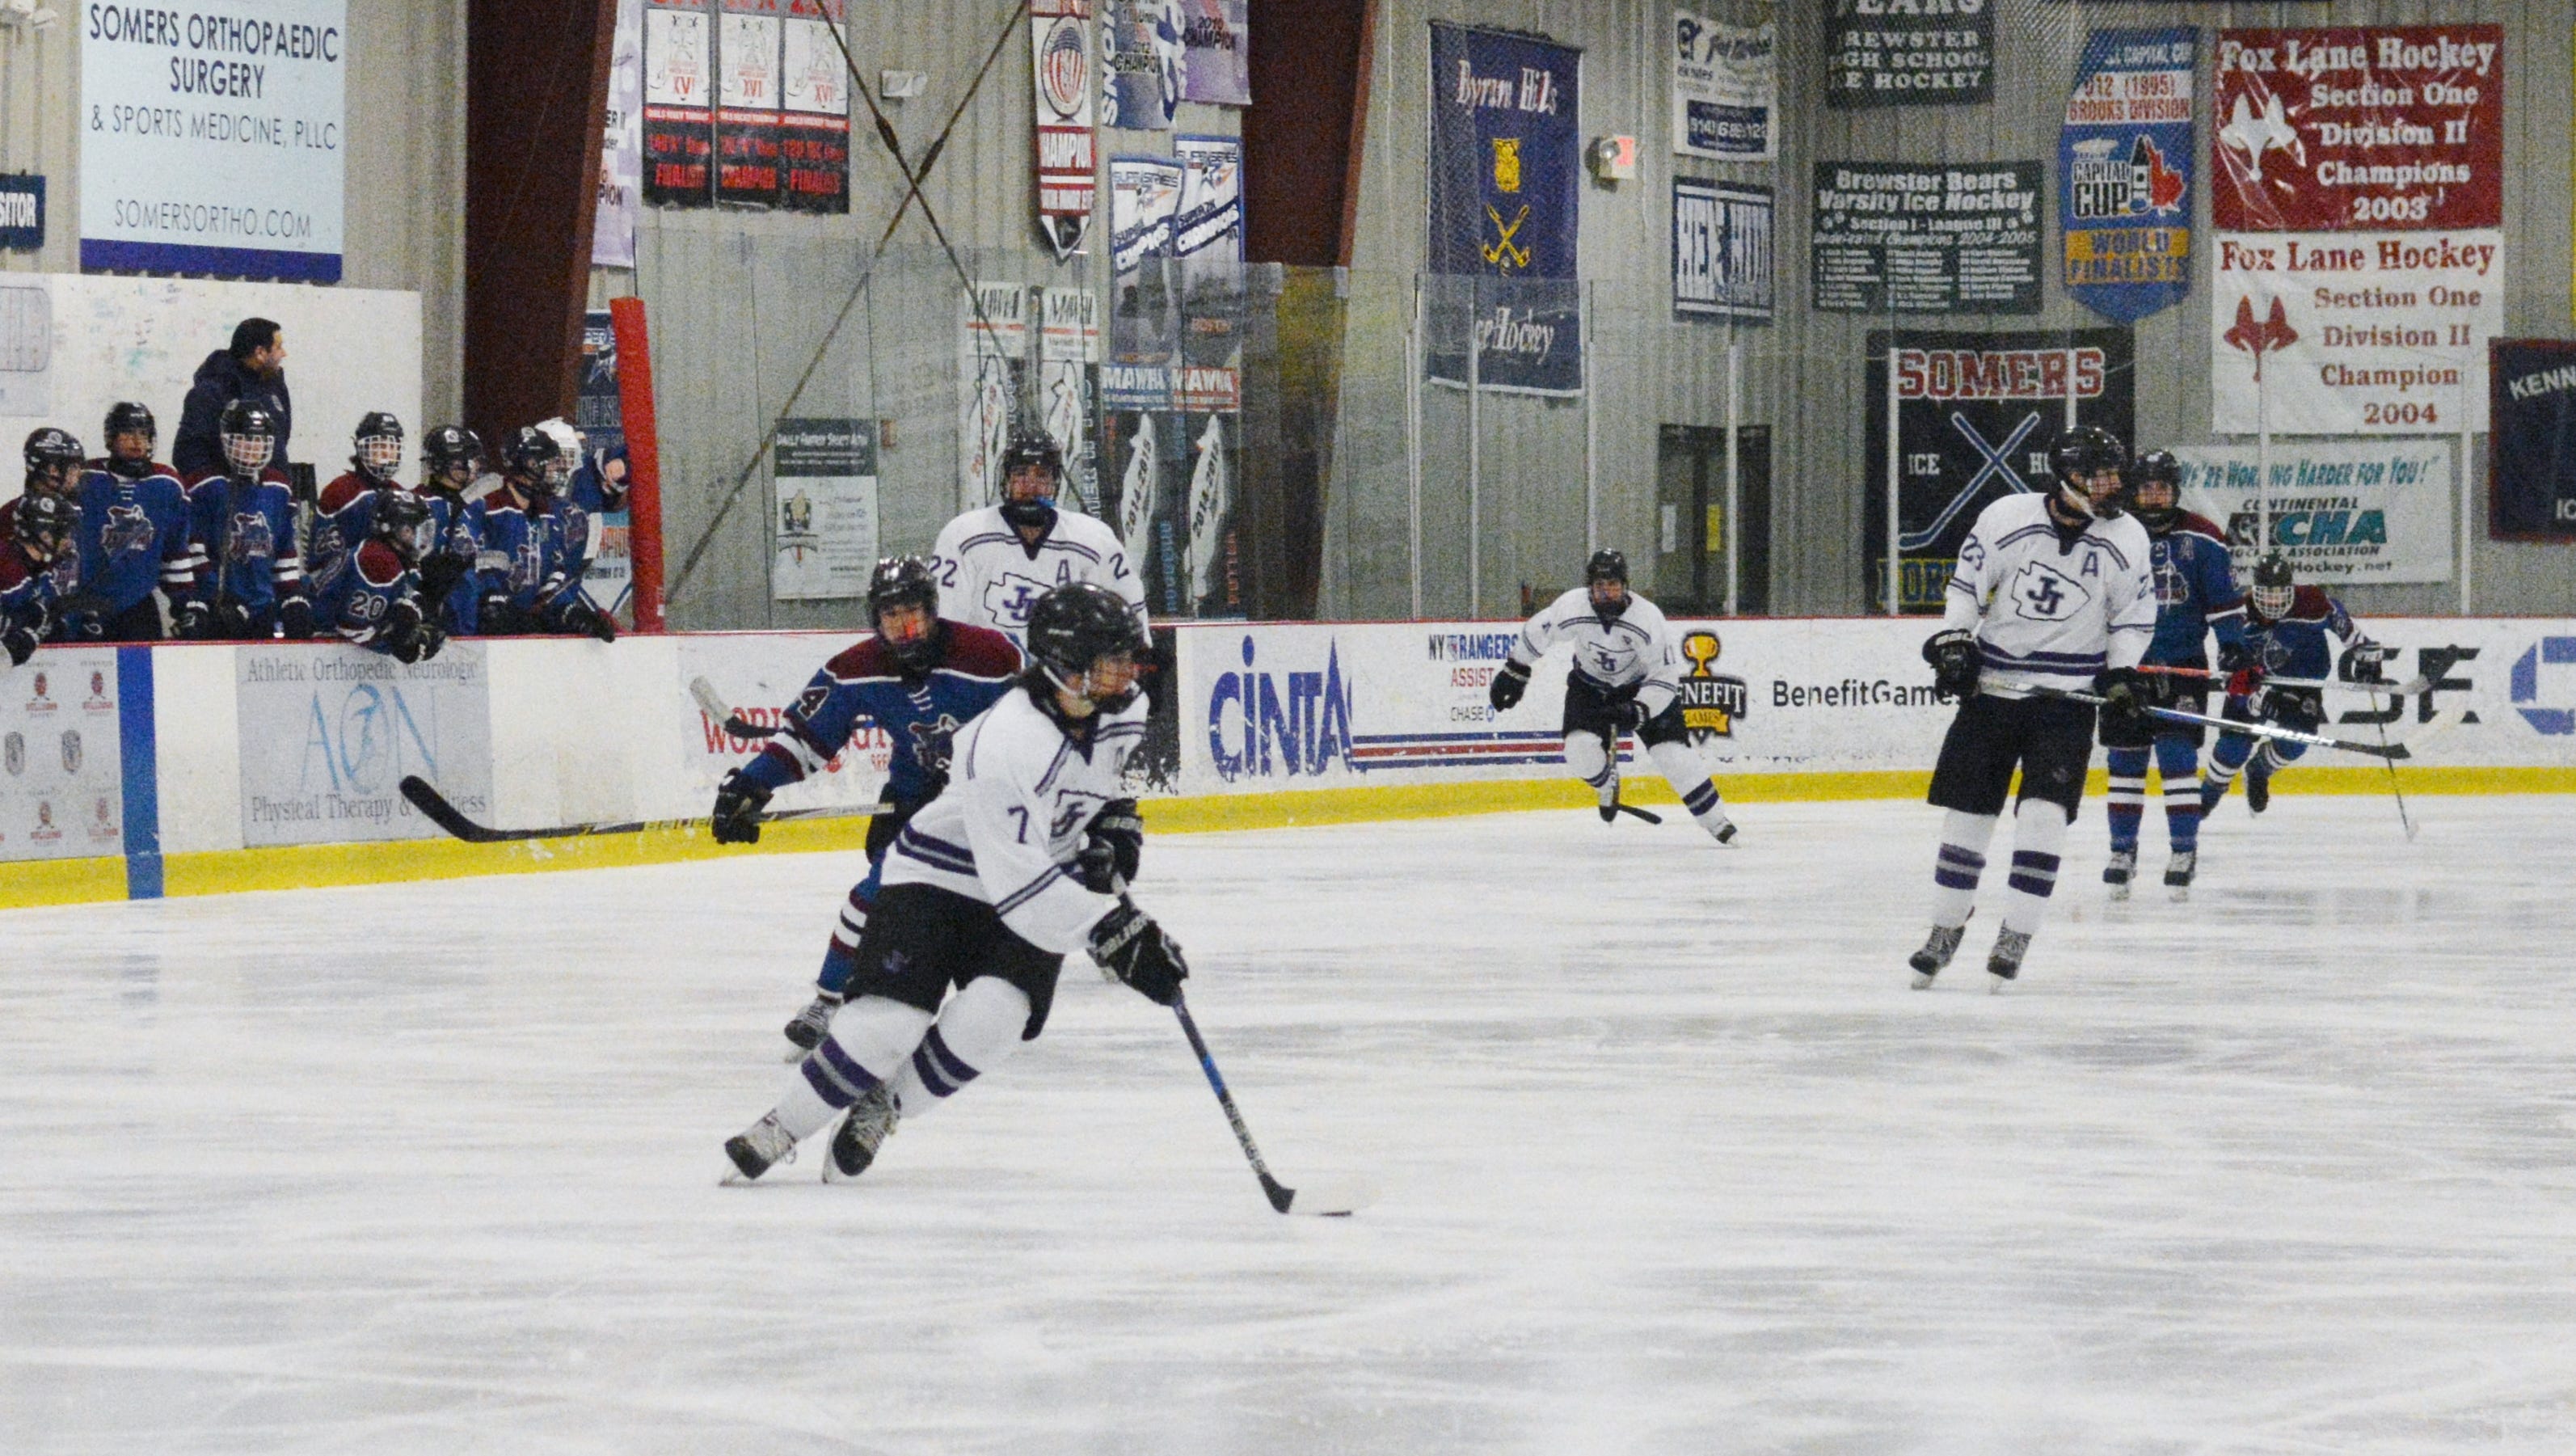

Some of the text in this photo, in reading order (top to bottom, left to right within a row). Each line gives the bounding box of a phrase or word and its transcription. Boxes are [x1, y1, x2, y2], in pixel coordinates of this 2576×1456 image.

[90, 3, 338, 62] SOMERS ORTHOPAEDIC
[2221, 36, 2496, 76] Fox Lane Hockey
[170, 57, 264, 99] SURGERY
[1874, 71, 1982, 89] HOCKEY
[2310, 82, 2478, 108] Section One
[91, 104, 336, 150] & SPORTS MEDICINE, PLLC
[2320, 120, 2468, 147] Division II
[1836, 169, 2017, 191] Brewster Bears
[2317, 161, 2471, 188] Champions
[1818, 189, 2035, 212] Varsity Ice Hockey
[2073, 182, 2129, 217] CUP
[2354, 196, 2428, 221] 2003
[115, 199, 311, 238] SOMERSORTHO.COM
[2221, 238, 2494, 275] Fox Lane Hockey
[2315, 286, 2481, 309] Section One
[2323, 325, 2470, 347] Division II
[1898, 348, 2105, 398] SOMERS
[2321, 365, 2458, 391] Champion
[2364, 403, 2437, 424] 2004
[1908, 454, 1939, 475] ICE
[2296, 458, 2353, 486] HARDER
[1110, 553, 1129, 580] 2
[2081, 551, 2098, 577] A
[348, 589, 387, 621] 20
[1429, 634, 1444, 660] NY
[247, 658, 306, 682] Athletic
[313, 657, 396, 686] Orthopedic
[1209, 635, 1351, 781] CINTA
[1451, 707, 1483, 721] CHASE
[252, 795, 319, 833] Physical
[326, 793, 392, 825] Therapy
[1008, 805, 1029, 844] 7
